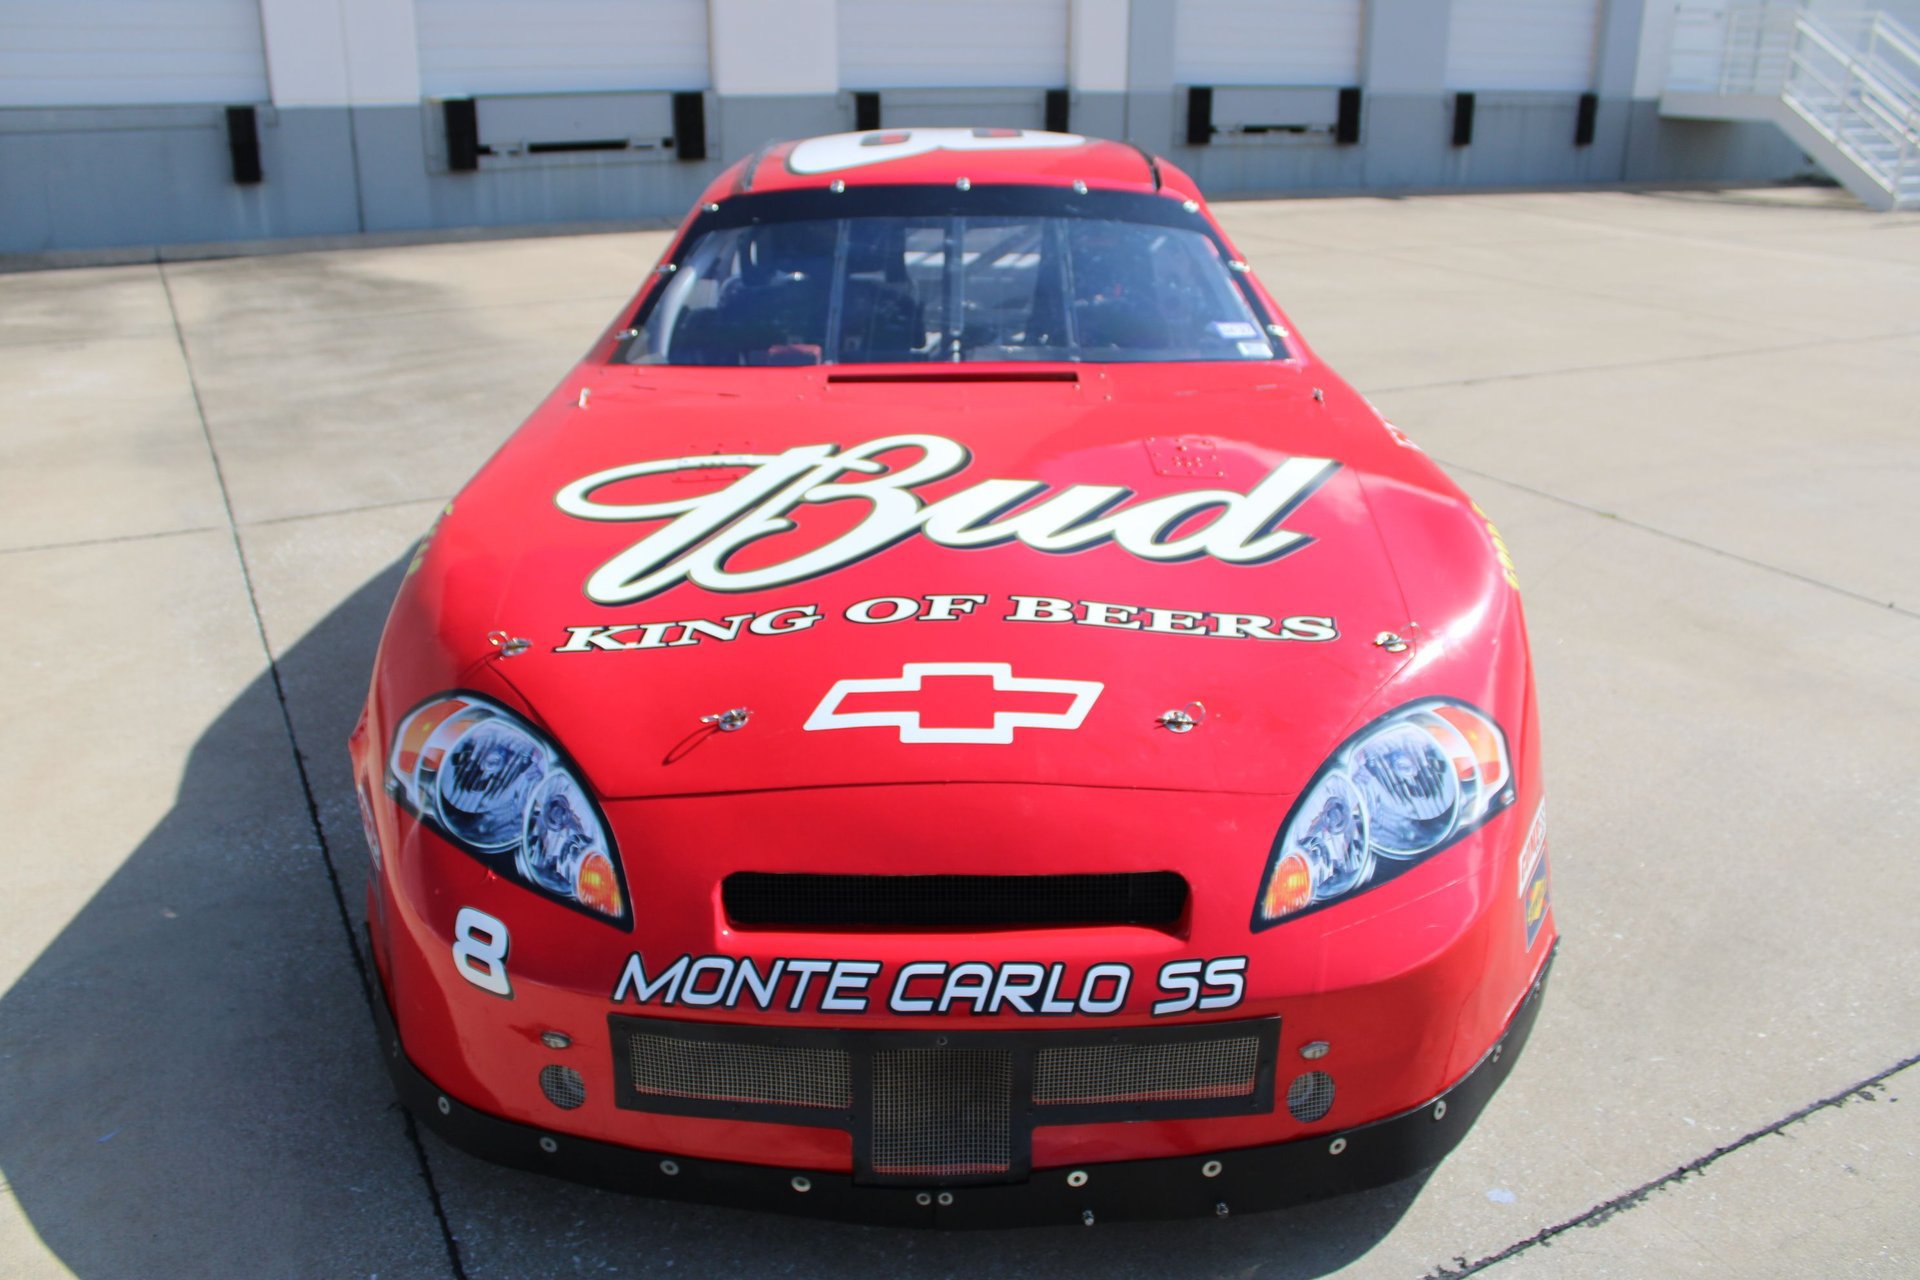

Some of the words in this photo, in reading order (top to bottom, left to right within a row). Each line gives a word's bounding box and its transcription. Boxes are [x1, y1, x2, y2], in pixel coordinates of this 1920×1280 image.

[554, 434, 1340, 605] Bud
[553, 604, 821, 653] KING
[843, 594, 987, 624] OF
[1006, 595, 1339, 642] BEERS
[452, 906, 514, 999] 8
[611, 952, 881, 1012] MONTE
[888, 962, 1133, 1016] CARLO
[1153, 956, 1249, 1016] SS
